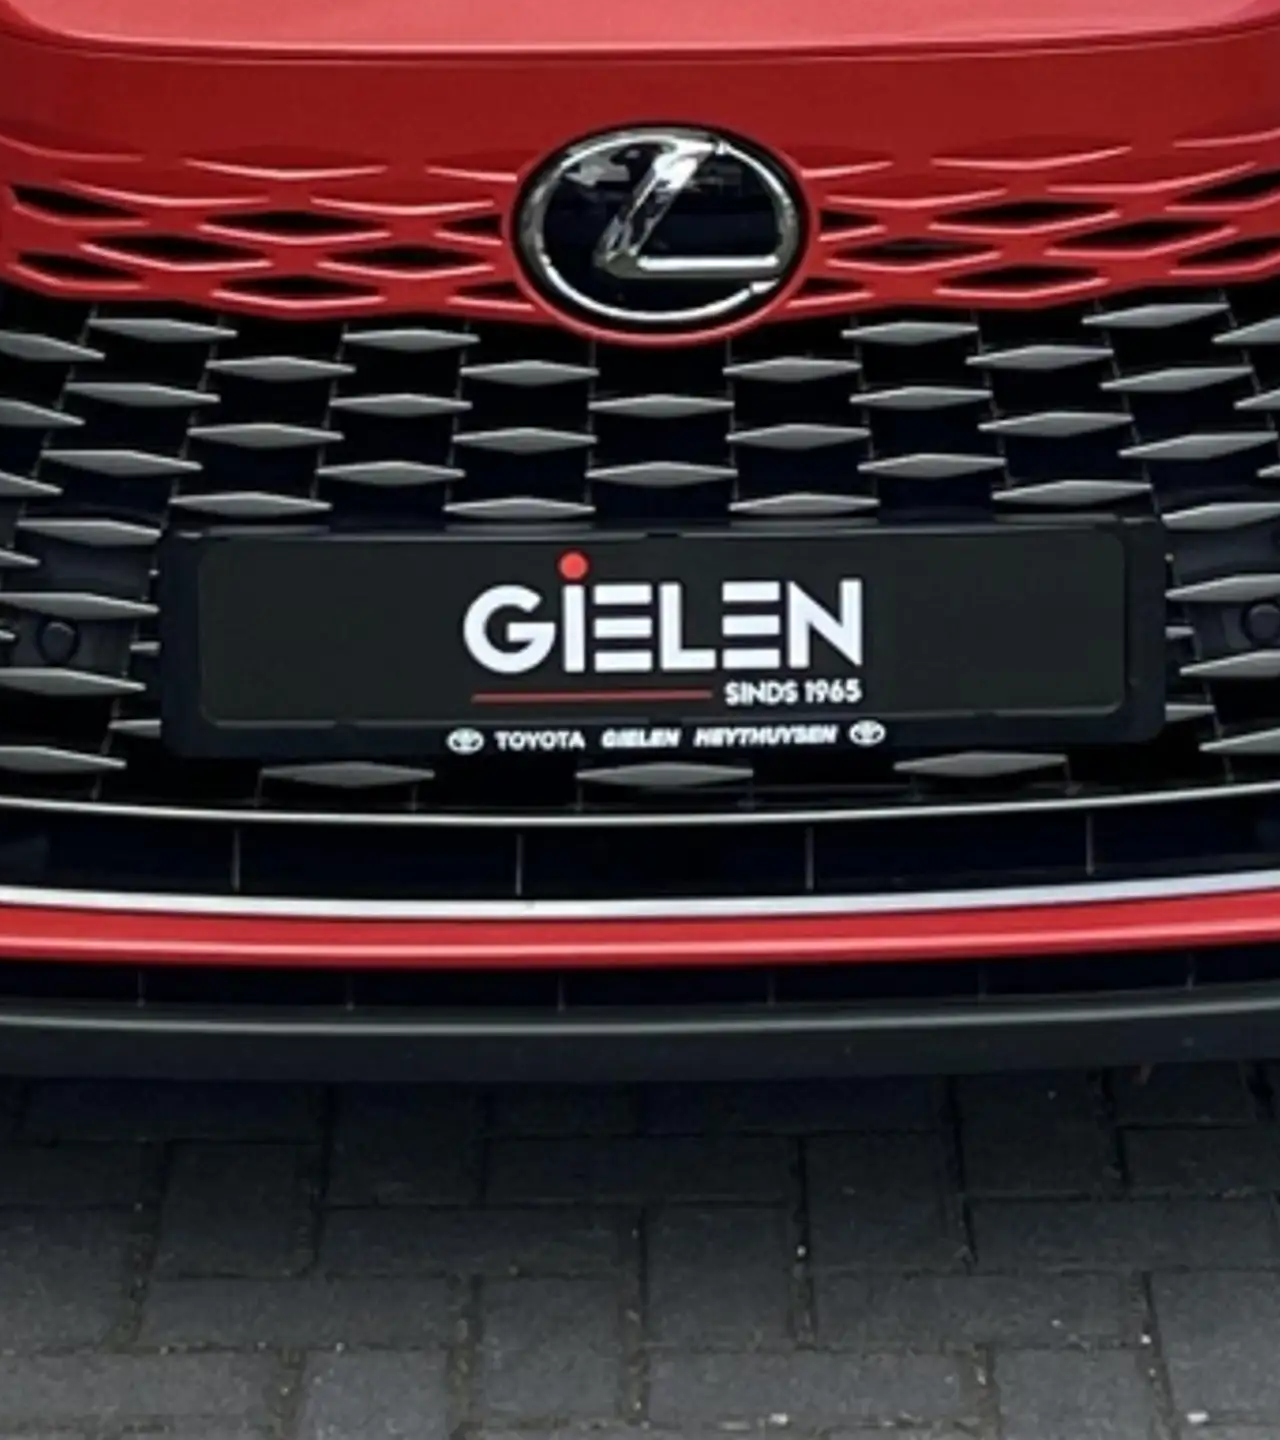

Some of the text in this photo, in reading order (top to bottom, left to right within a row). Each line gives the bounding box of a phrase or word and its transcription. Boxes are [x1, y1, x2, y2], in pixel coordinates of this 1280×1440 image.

[725, 679, 862, 705] SINDS 1965
[494, 730, 586, 751] TOYOTA
[601, 728, 682, 748] GIELEN
